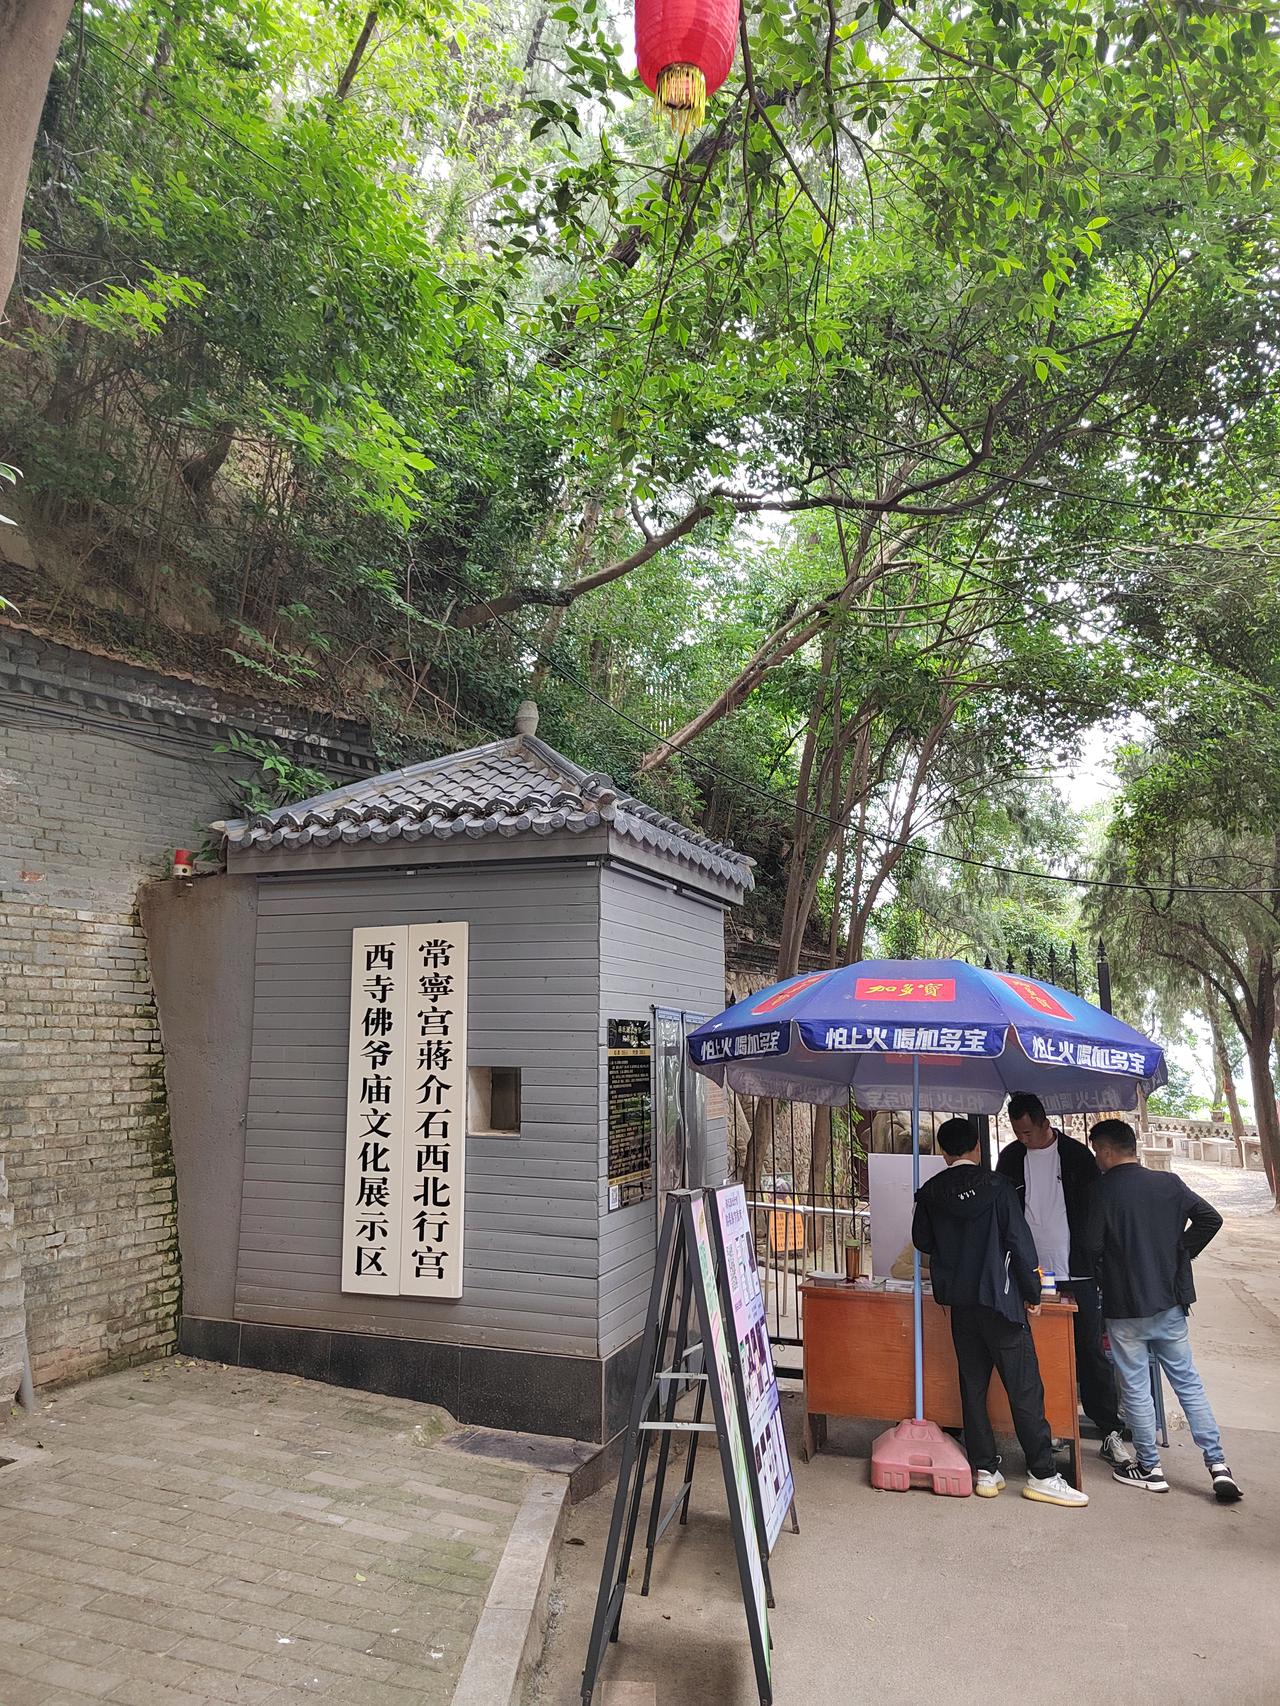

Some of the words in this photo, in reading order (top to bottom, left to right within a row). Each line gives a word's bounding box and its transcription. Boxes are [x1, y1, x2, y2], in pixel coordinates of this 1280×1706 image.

[866, 983, 943, 996] 加多寶
[701, 1031, 780, 1061] 怕上火喝加多宝
[826, 1027, 987, 1051] 怕上火喝加多宝
[1032, 1036, 1146, 1075] 怕上火喝加多宝
[355, 942, 396, 1277] 西寺佛爷庙文化展示区
